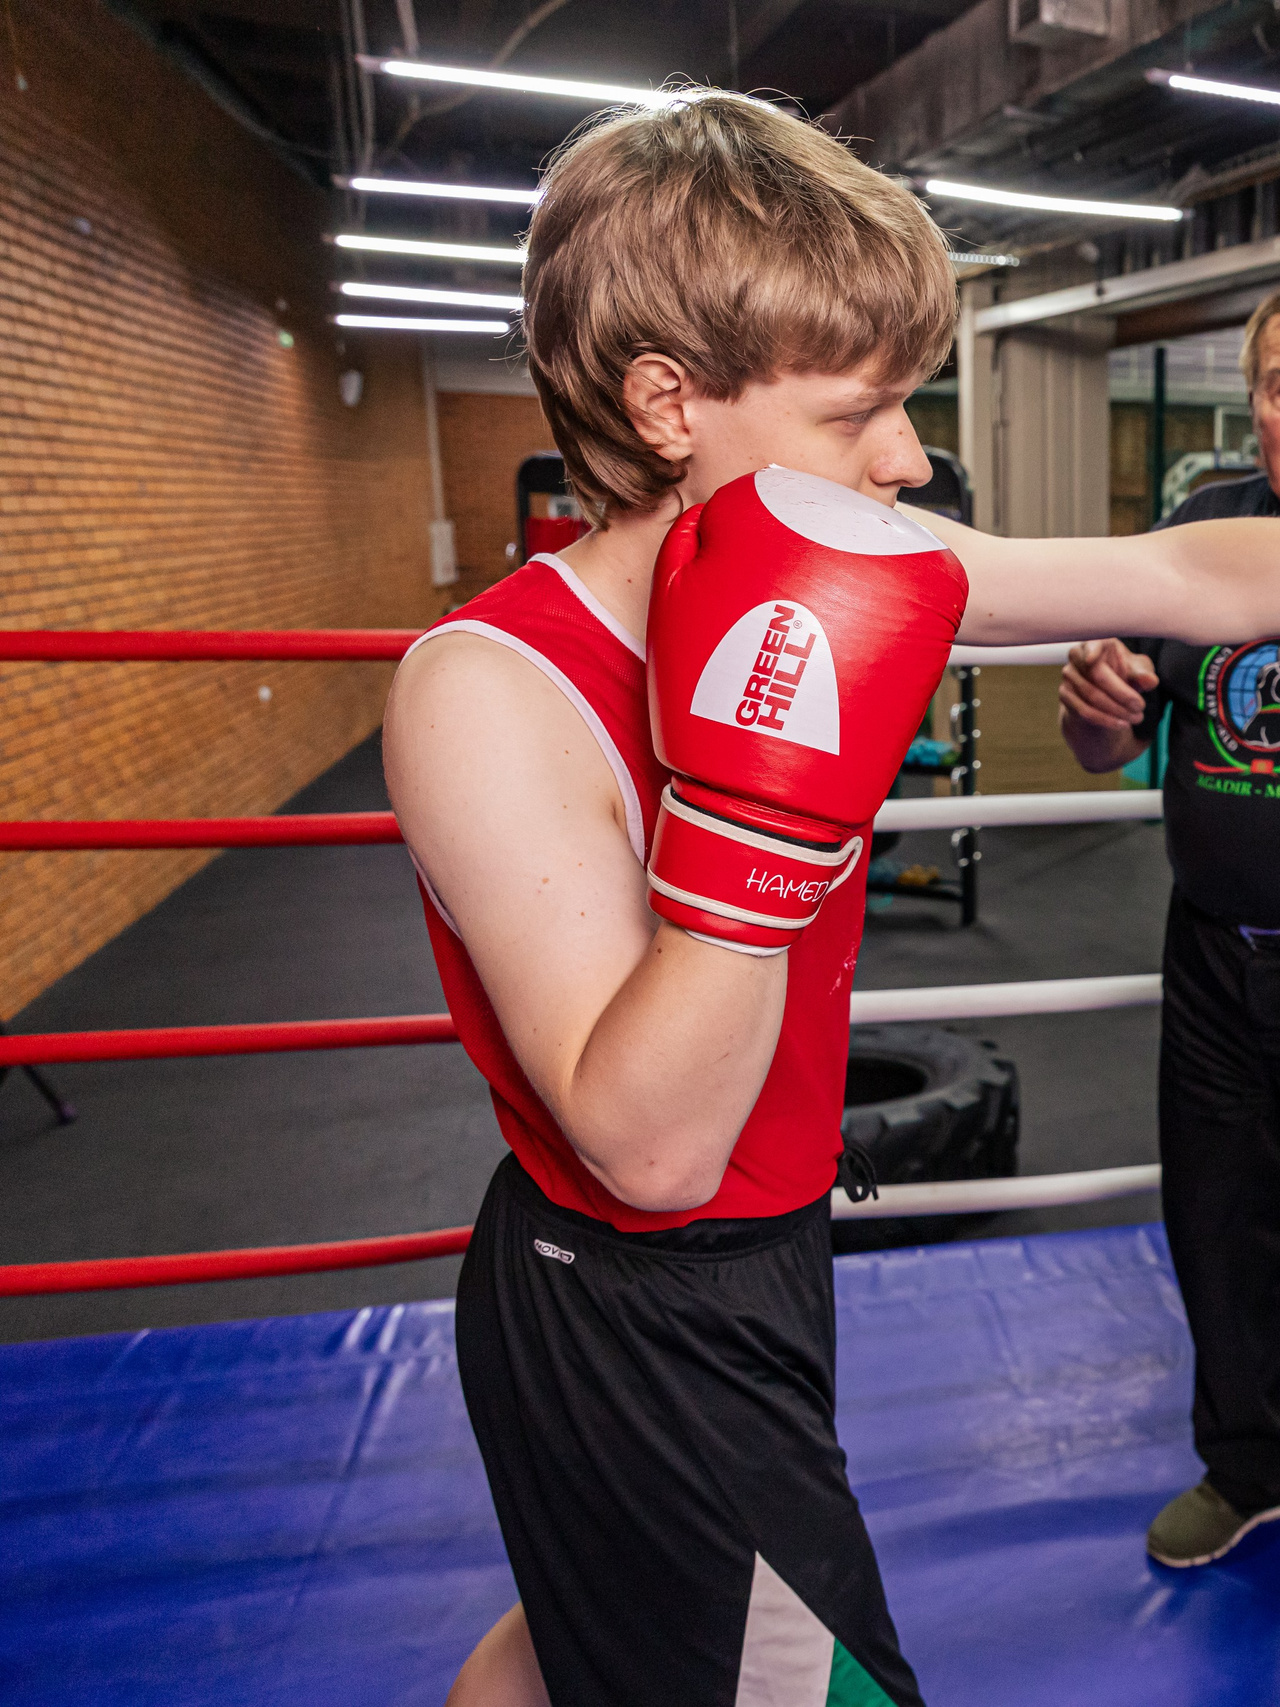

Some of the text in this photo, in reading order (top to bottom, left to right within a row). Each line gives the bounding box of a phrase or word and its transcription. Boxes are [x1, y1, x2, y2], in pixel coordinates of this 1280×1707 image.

[735, 604, 796, 727] GREEN
[756, 633, 817, 731] HILL
[747, 868, 829, 902] HAMED
